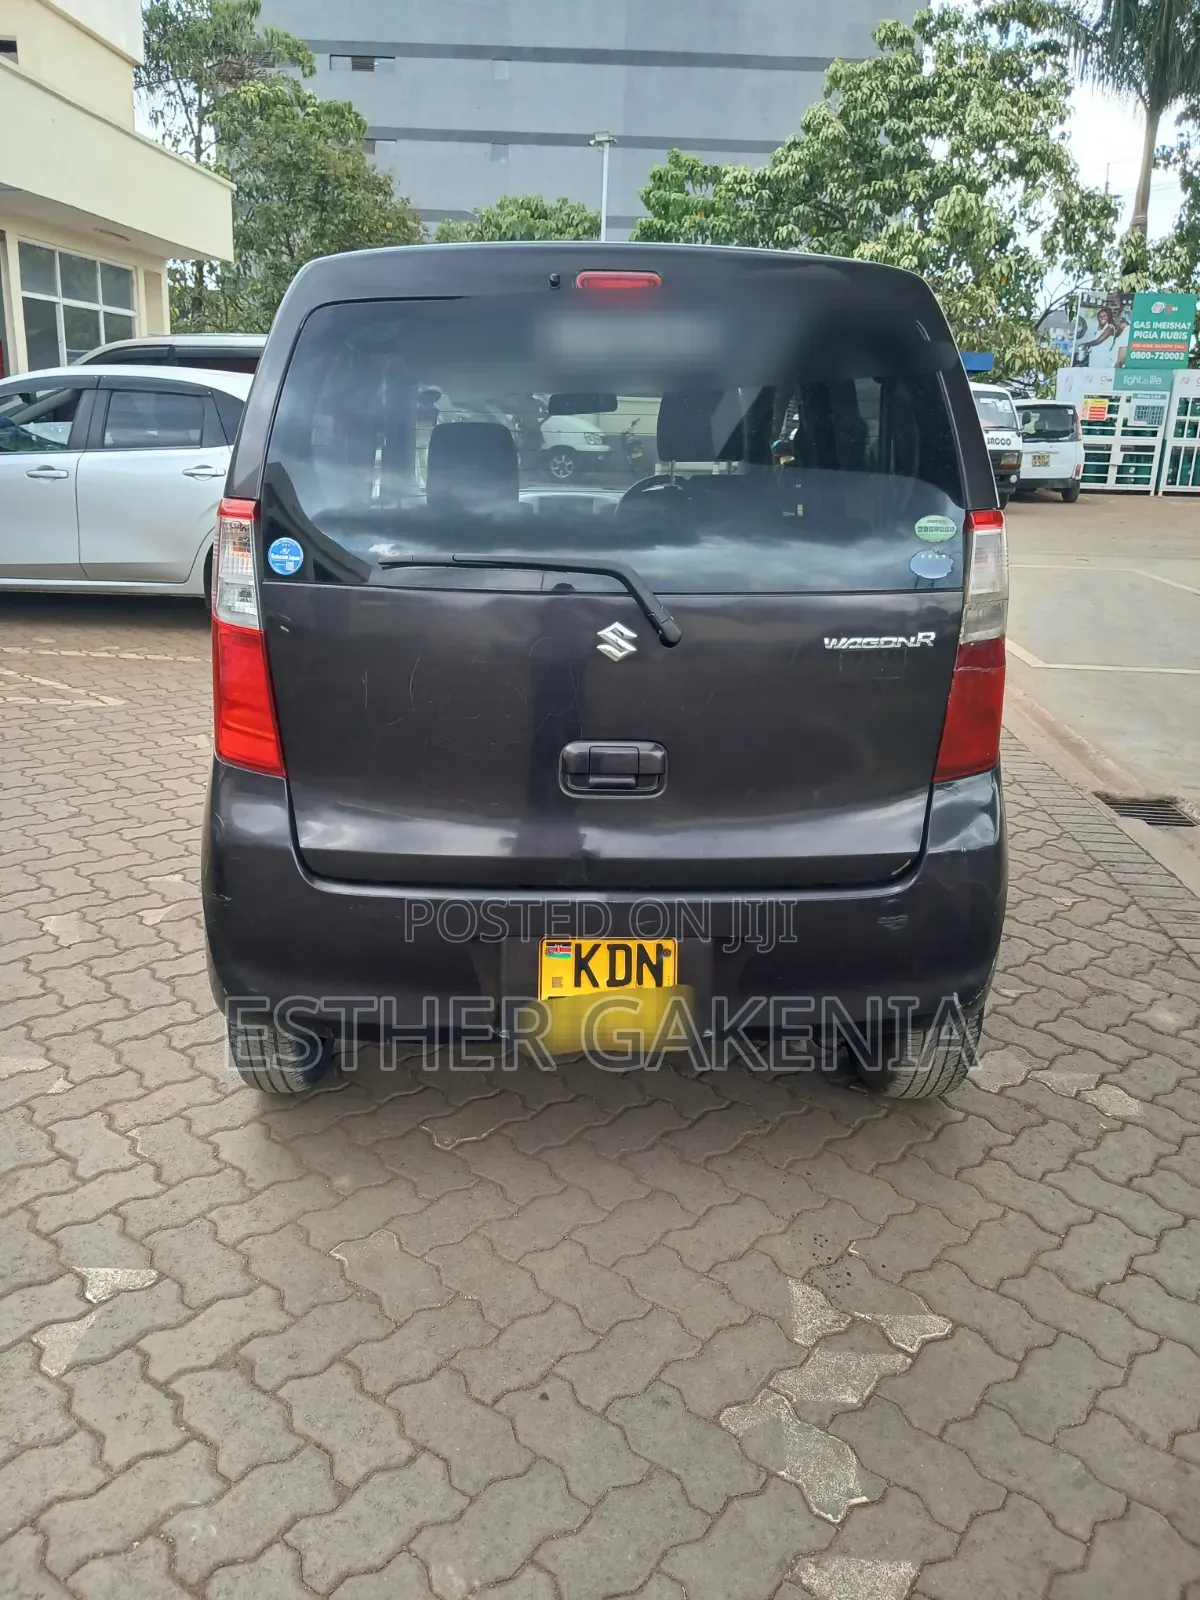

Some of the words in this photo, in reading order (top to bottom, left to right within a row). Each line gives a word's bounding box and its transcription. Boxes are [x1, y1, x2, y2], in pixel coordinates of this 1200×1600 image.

[1133, 321, 1151, 329] GAS
[1152, 321, 1191, 330] IMEISHA?
[1133, 331, 1158, 339] PIGIA
[1160, 331, 1188, 340] RUBIS
[1130, 351, 1185, 360] 0800-720002
[1123, 375, 1141, 386] light
[1149, 375, 1162, 385] life
[987, 437, 1012, 446] SACCO
[574, 943, 664, 988] KDN
